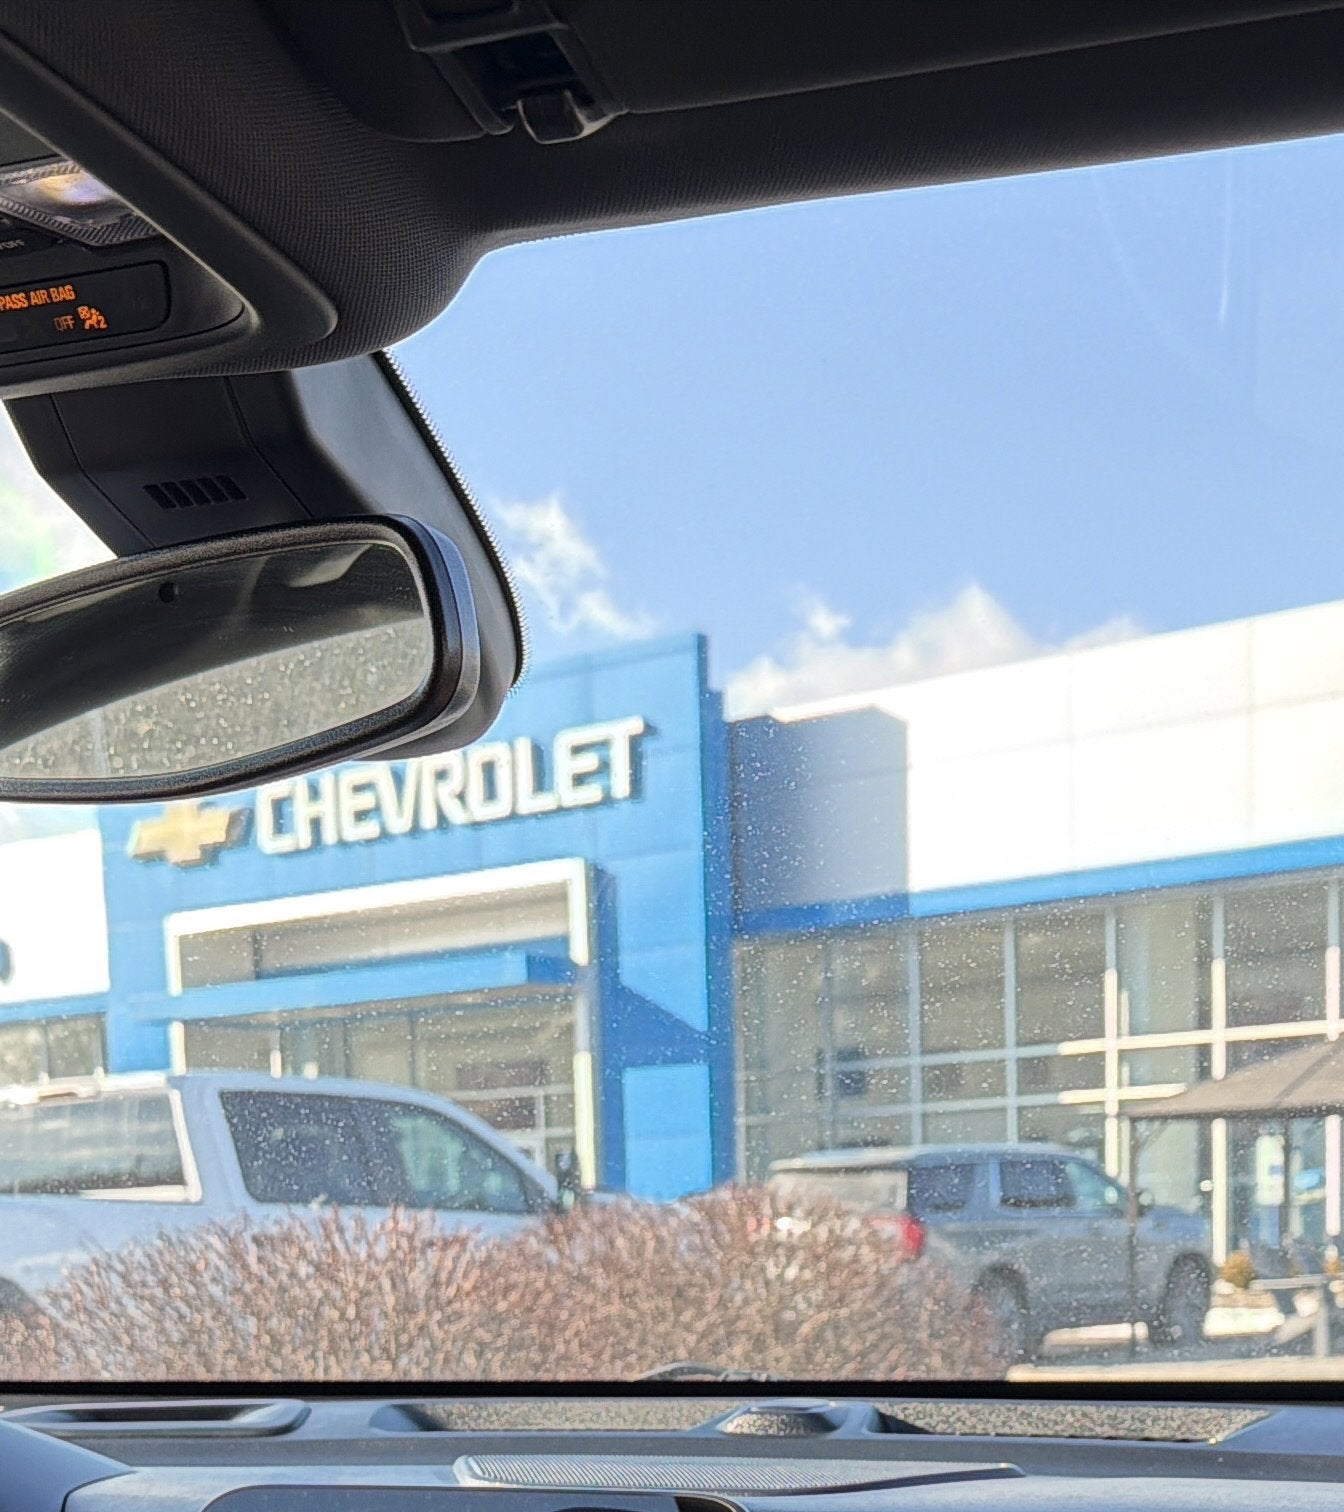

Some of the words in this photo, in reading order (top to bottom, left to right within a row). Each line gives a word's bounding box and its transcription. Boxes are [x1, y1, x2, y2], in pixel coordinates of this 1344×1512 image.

[29, 289, 51, 307] AIR
[50, 284, 76, 303] BAG
[54, 315, 75, 331] OFF
[256, 715, 646, 856] CHEVROLET
